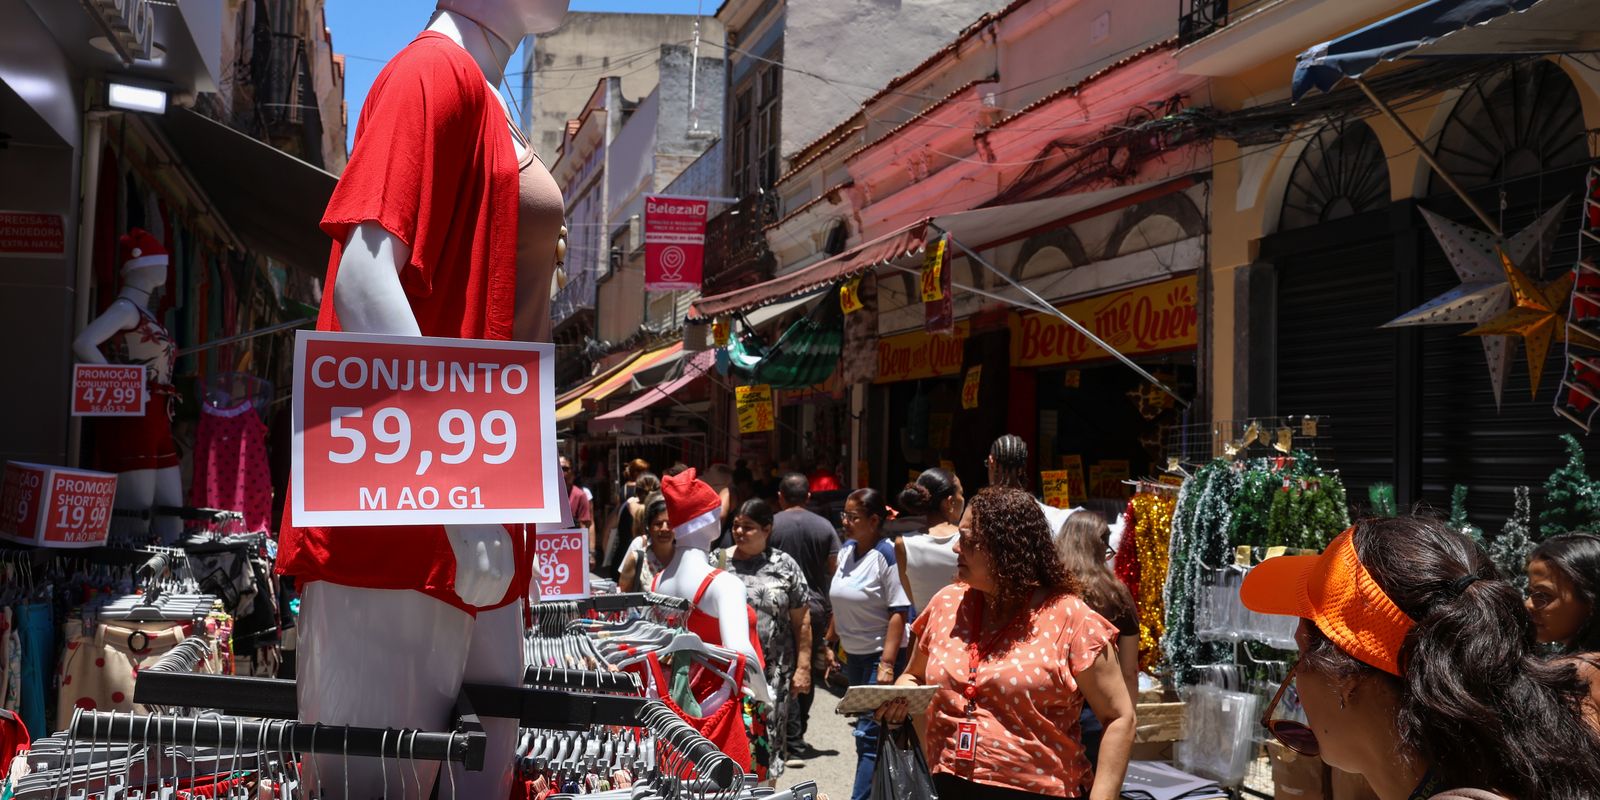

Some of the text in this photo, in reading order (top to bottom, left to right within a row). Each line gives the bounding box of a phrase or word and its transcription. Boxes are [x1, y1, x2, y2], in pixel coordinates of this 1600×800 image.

[1021, 296, 1197, 360] Bem me Quer
[880, 341, 913, 378] Bem
[929, 334, 964, 375] Quer
[77, 381, 141, 389] CONJUNTO PLUS
[78, 369, 138, 381] PROMOÇÃO
[311, 355, 528, 395] CONJUNTO
[82, 388, 136, 406] 47,99
[328, 406, 517, 476] 59,99
[57, 493, 96, 507] SHORT
[359, 486, 485, 510] M AO G1
[56, 505, 106, 533] 19,99
[64, 532, 74, 543] M
[545, 586, 561, 595] GG
